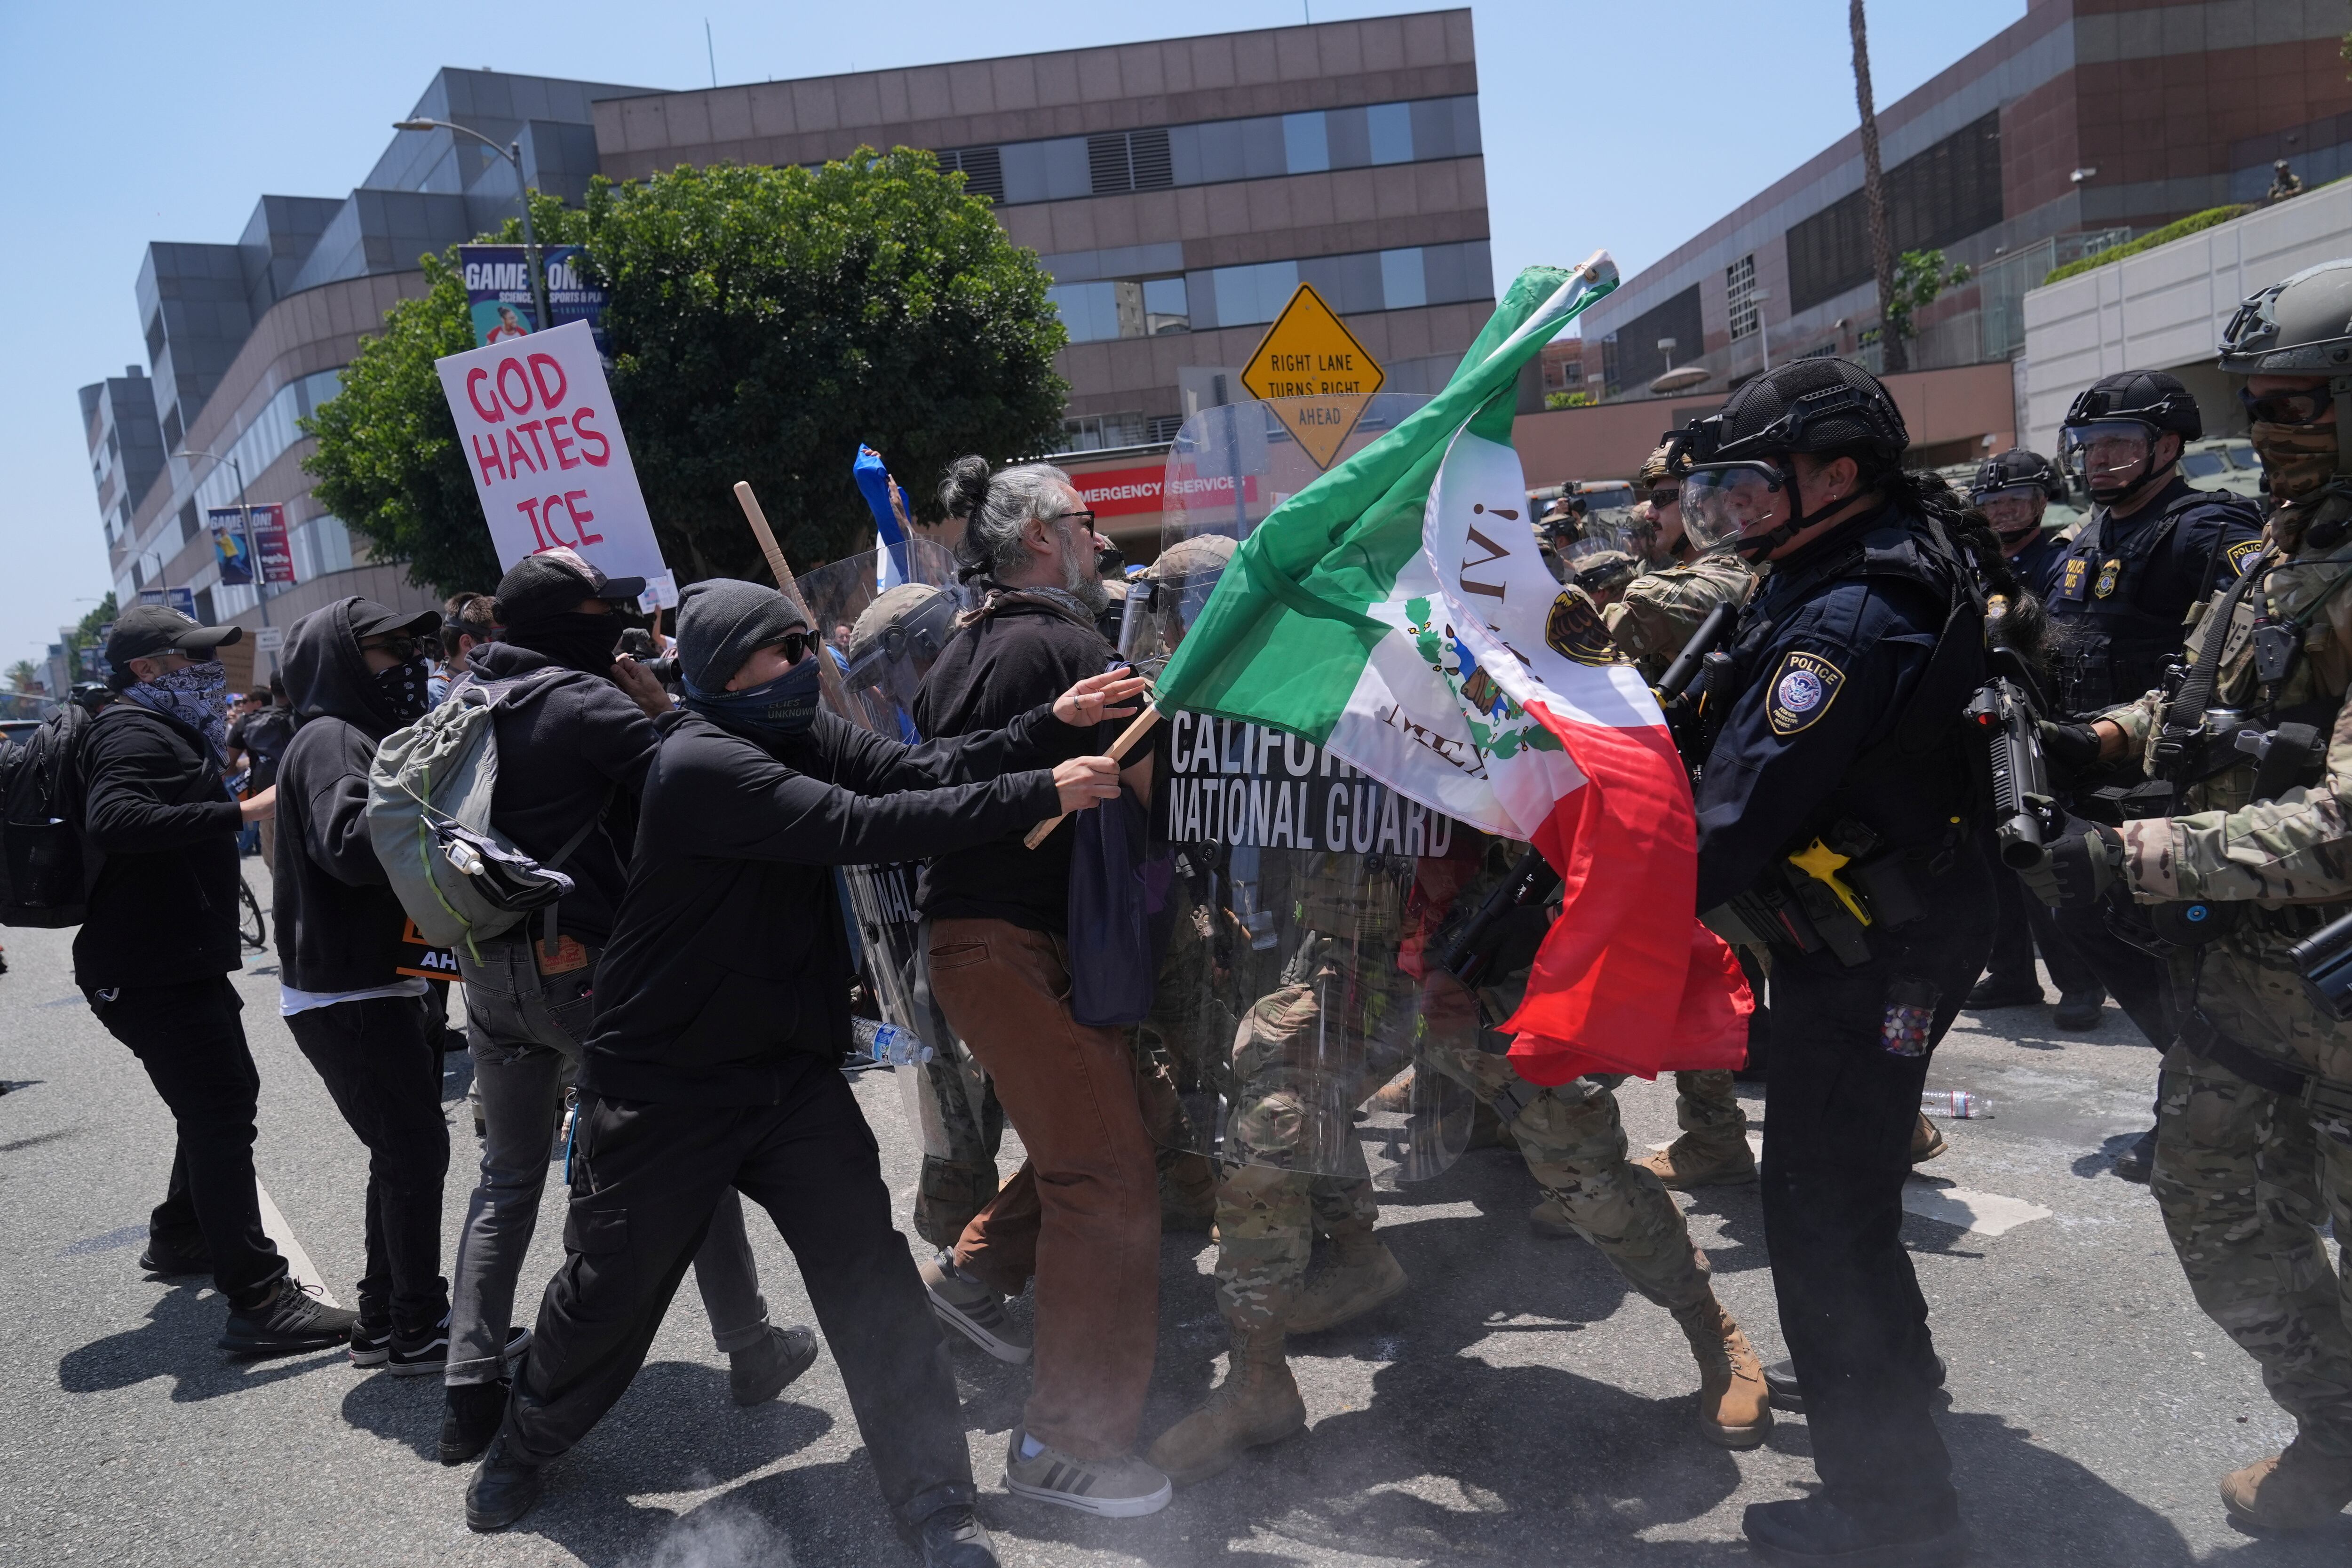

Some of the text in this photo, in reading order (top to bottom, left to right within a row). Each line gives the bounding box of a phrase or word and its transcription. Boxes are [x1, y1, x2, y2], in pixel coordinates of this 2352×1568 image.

[465, 263, 584, 290] GAME ON!
[499, 292, 602, 304] SCIENCE, SPORTS & PLA
[1271, 354, 1353, 371] RIGHT LANE
[467, 353, 567, 423] GOD
[1268, 382, 1360, 399] TURNS RIGHT
[1299, 407, 1341, 426] AHEAD
[472, 407, 611, 486] HATES
[1077, 482, 1162, 503] MERGENCY
[211, 514, 242, 530] GAME
[252, 512, 272, 527] ON!
[517, 490, 604, 556] ICE
[2232, 544, 2261, 559] POLIC
[2066, 559, 2087, 574] POLICE
[2064, 573, 2077, 588] DHS
[1789, 656, 1838, 685] POLICE
[768, 707, 815, 719] UNKNOWN
[1773, 709, 1799, 724] PROTECTIVE
[1778, 707, 1797, 718] FEDERAL
[1774, 718, 1791, 729] SERVICE
[1168, 778, 1453, 858] NATIONAL GUARD
